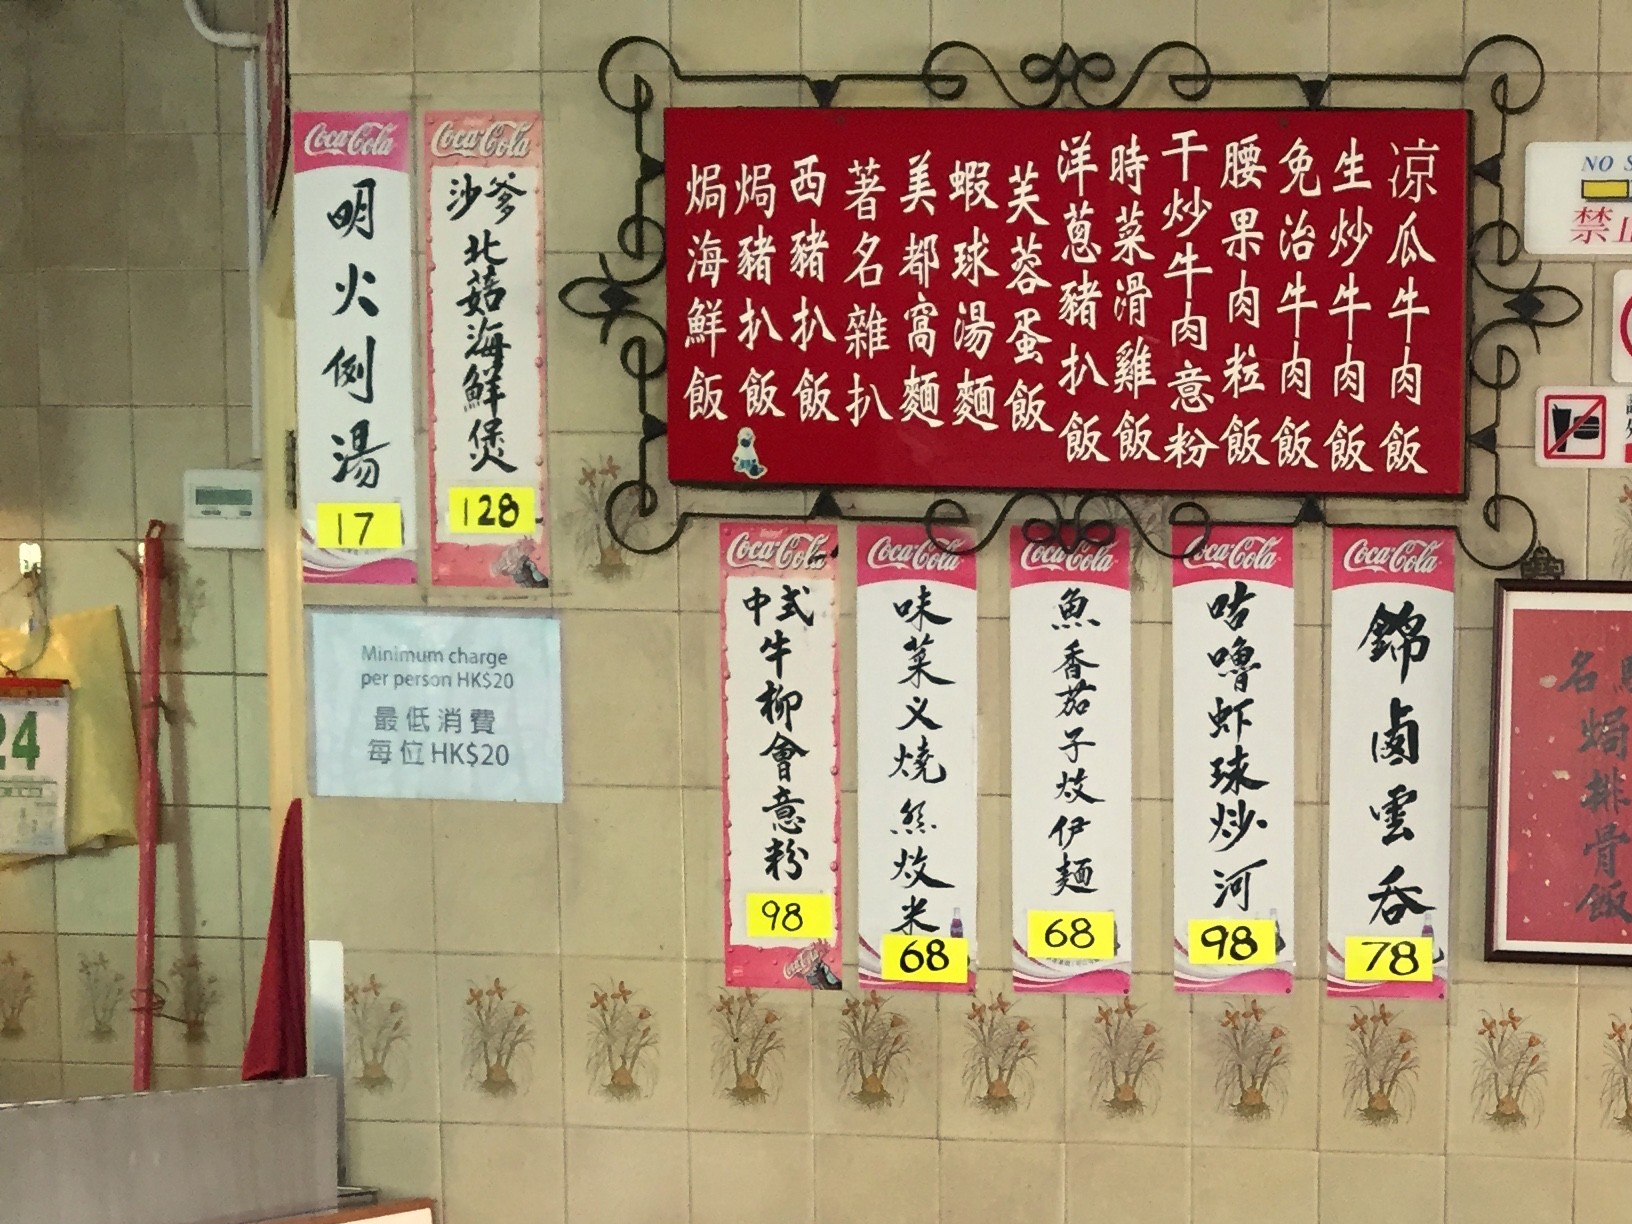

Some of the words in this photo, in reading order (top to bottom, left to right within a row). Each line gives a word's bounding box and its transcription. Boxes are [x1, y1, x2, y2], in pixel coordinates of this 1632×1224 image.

[304, 121, 395, 158] Coca-Cola
[430, 119, 531, 159] Coca-Cola
[1582, 155, 1613, 172] NO
[684, 164, 728, 420] 焗海鮮飯
[735, 164, 785, 416] 焗豬扒飯
[790, 155, 839, 421] 西豬扒飯
[844, 157, 893, 427] 著名雜扒
[899, 150, 944, 427] 美都窩麵
[949, 160, 999, 431] 蝦球湯麵
[1004, 161, 1054, 431] 芙蓉蛋飯
[1162, 130, 1219, 468] 干炒牛肉意粉
[1219, 134, 1270, 465] 腰果肉粒飯
[1271, 137, 1321, 468] 免治牛肉飯
[1323, 137, 1373, 472] 生炒牛肉飯
[321, 177, 391, 489] 明火例湯
[338, 511, 375, 545] 17
[463, 492, 520, 528] 128
[867, 535, 962, 572] Coca-Cola
[1344, 535, 1444, 574] Coca-Cola
[361, 645, 444, 662] Minimum
[448, 647, 508, 668] charge
[361, 672, 389, 689] per
[394, 674, 452, 690] person
[457, 671, 514, 690] HK$20
[373, 706, 497, 734] 最低消費
[742, 584, 816, 881] 中式牛柳會意粉
[761, 901, 804, 932] 98
[1044, 917, 1096, 949] 68
[899, 938, 951, 975] 68
[1200, 924, 1259, 961] 98
[1361, 940, 1421, 976] 78
